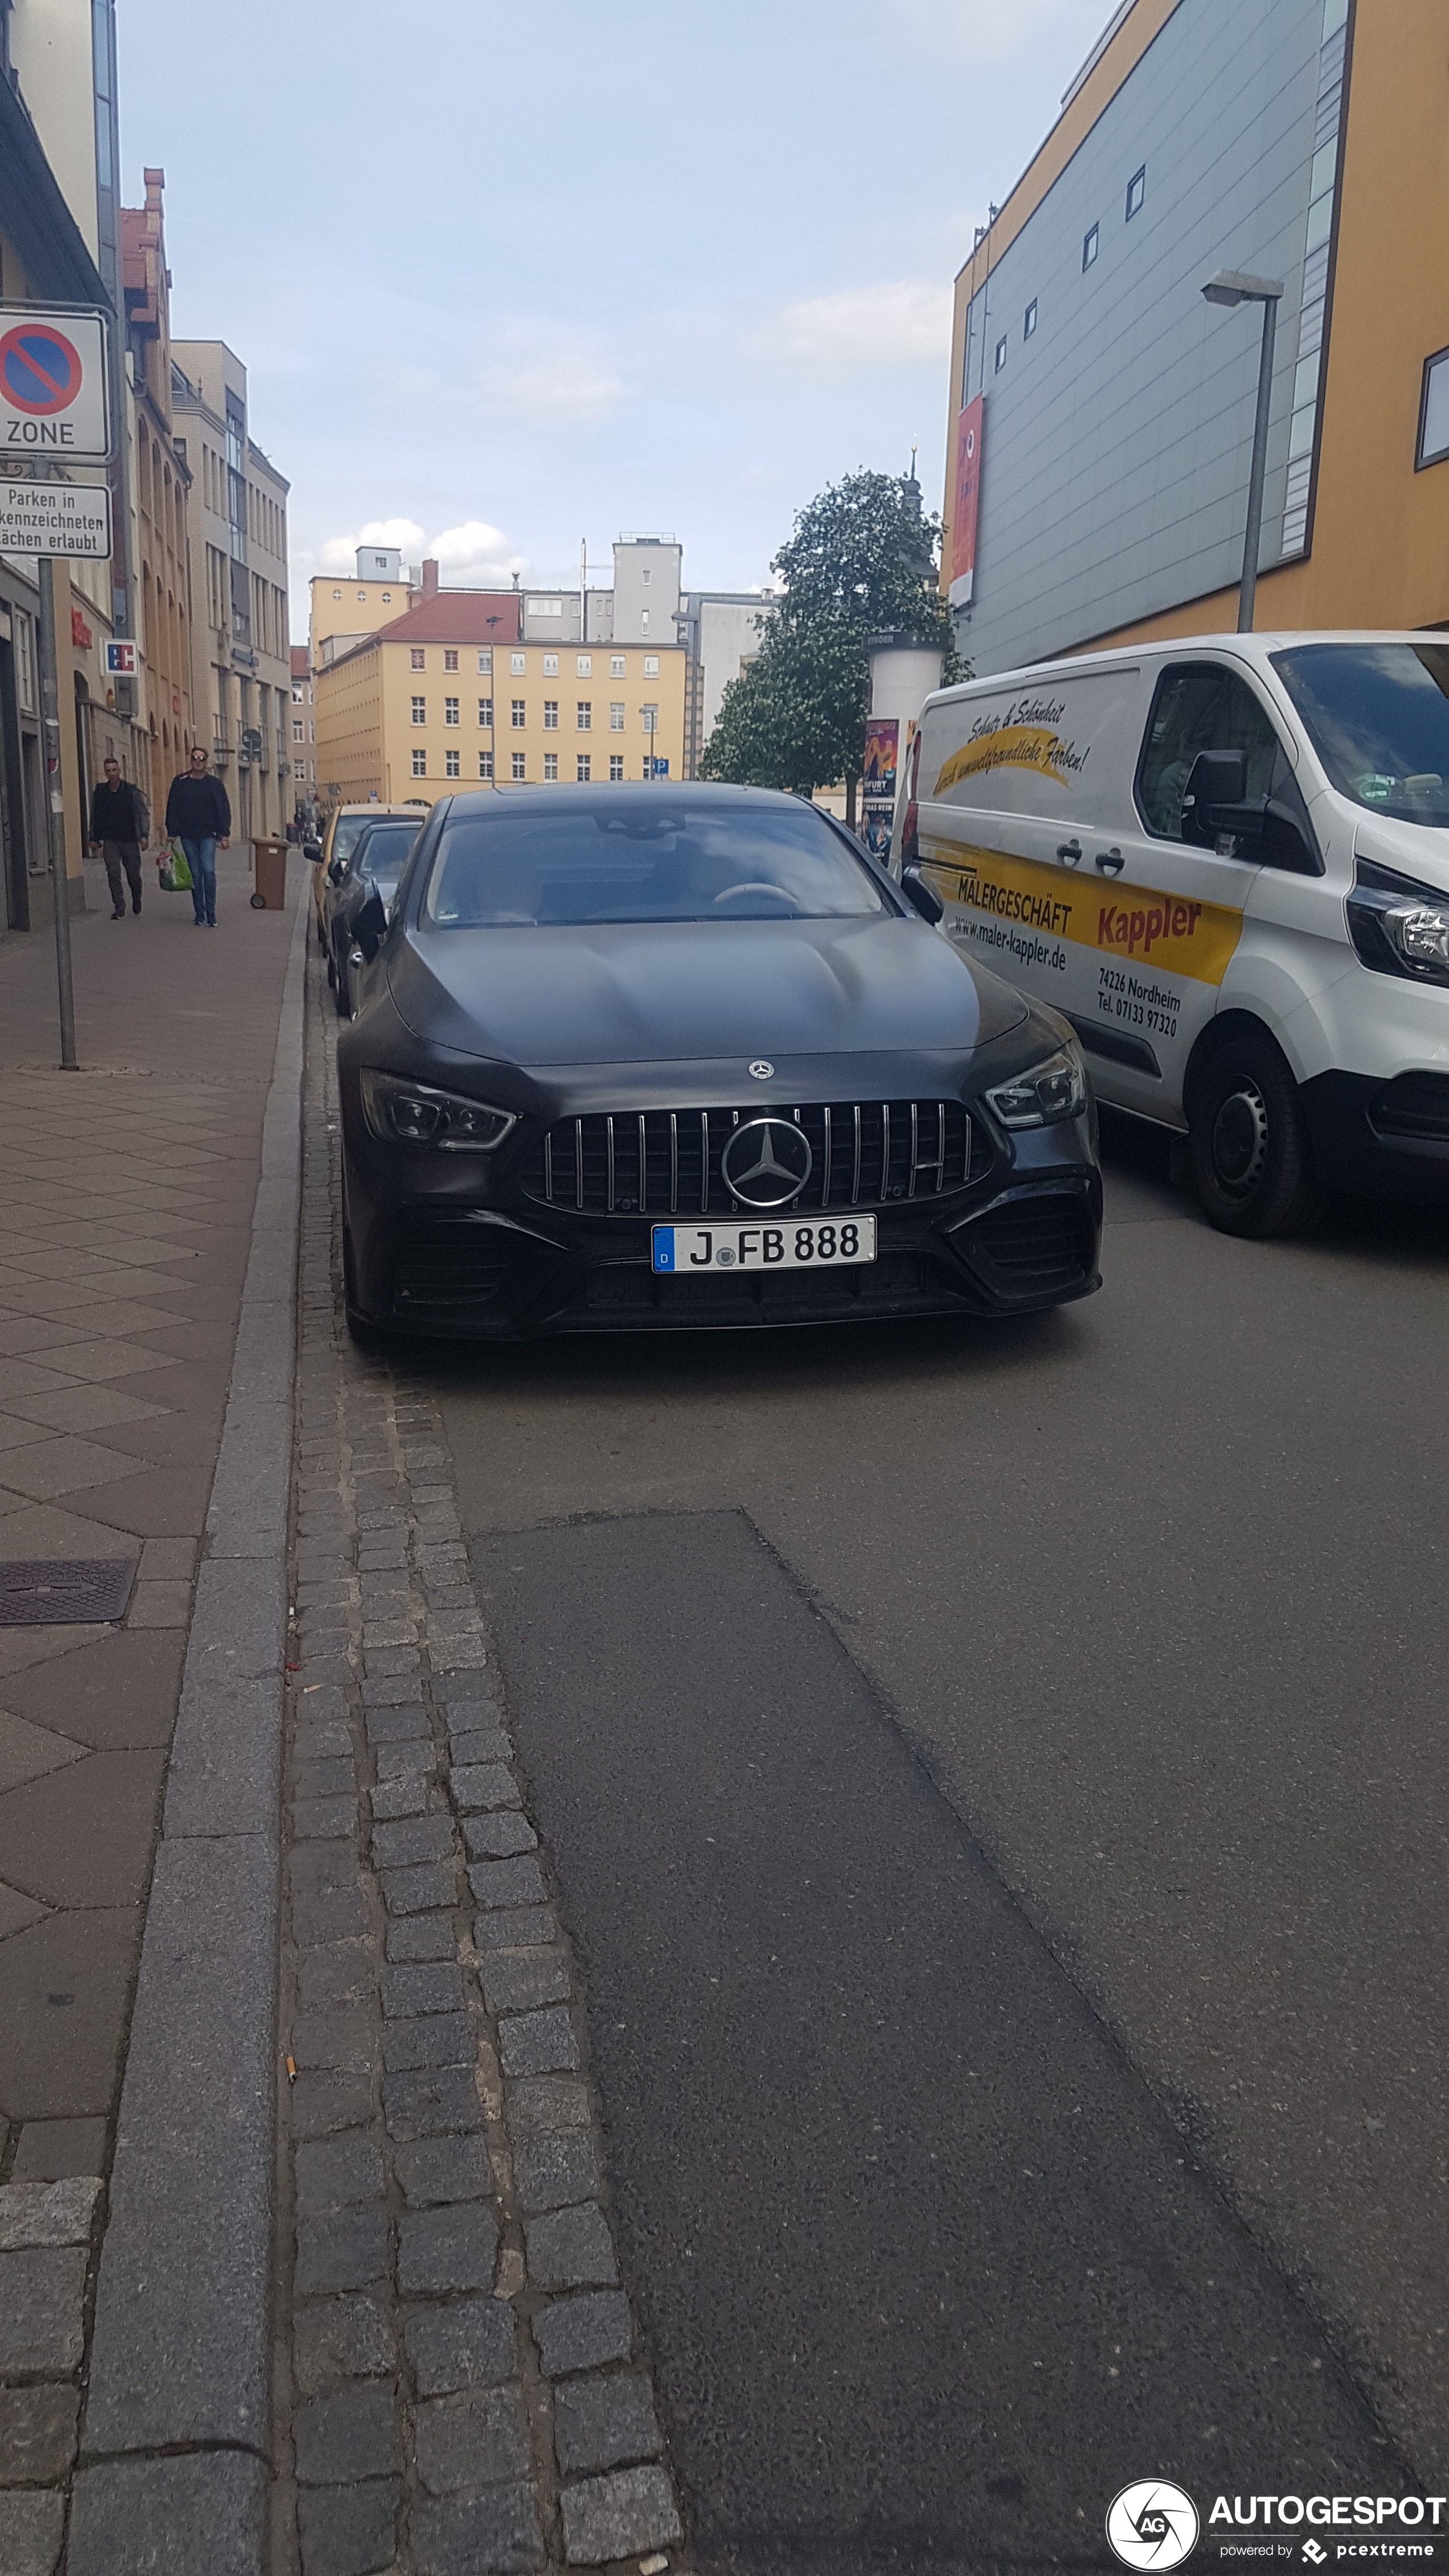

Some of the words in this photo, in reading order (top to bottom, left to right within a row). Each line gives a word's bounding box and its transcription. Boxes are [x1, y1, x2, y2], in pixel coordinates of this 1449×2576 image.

[7, 421, 74, 444] ZONE
[9, 489, 56, 508] Parken
[63, 492, 75, 509] in
[0, 529, 42, 547] ächen
[49, 533, 97, 550] erlaubt
[968, 714, 1001, 744] Schutz
[1002, 703, 1017, 729] &
[1013, 698, 1066, 725] Schönheit
[657, 760, 666, 773] P
[1043, 737, 1091, 772] Farben!
[955, 916, 1066, 971] www.maler-kappler.de
[1098, 899, 1202, 954] Kappler
[1100, 967, 1126, 993] 74226
[1128, 977, 1181, 1012] Nordheim
[1098, 991, 1113, 1013] Tel.
[1116, 998, 1144, 1024] 07133
[1147, 1009, 1177, 1038] 97320
[660, 1254, 668, 1263] D
[690, 1232, 713, 1265] J
[739, 1229, 784, 1263] FB
[795, 1224, 859, 1261] 888
